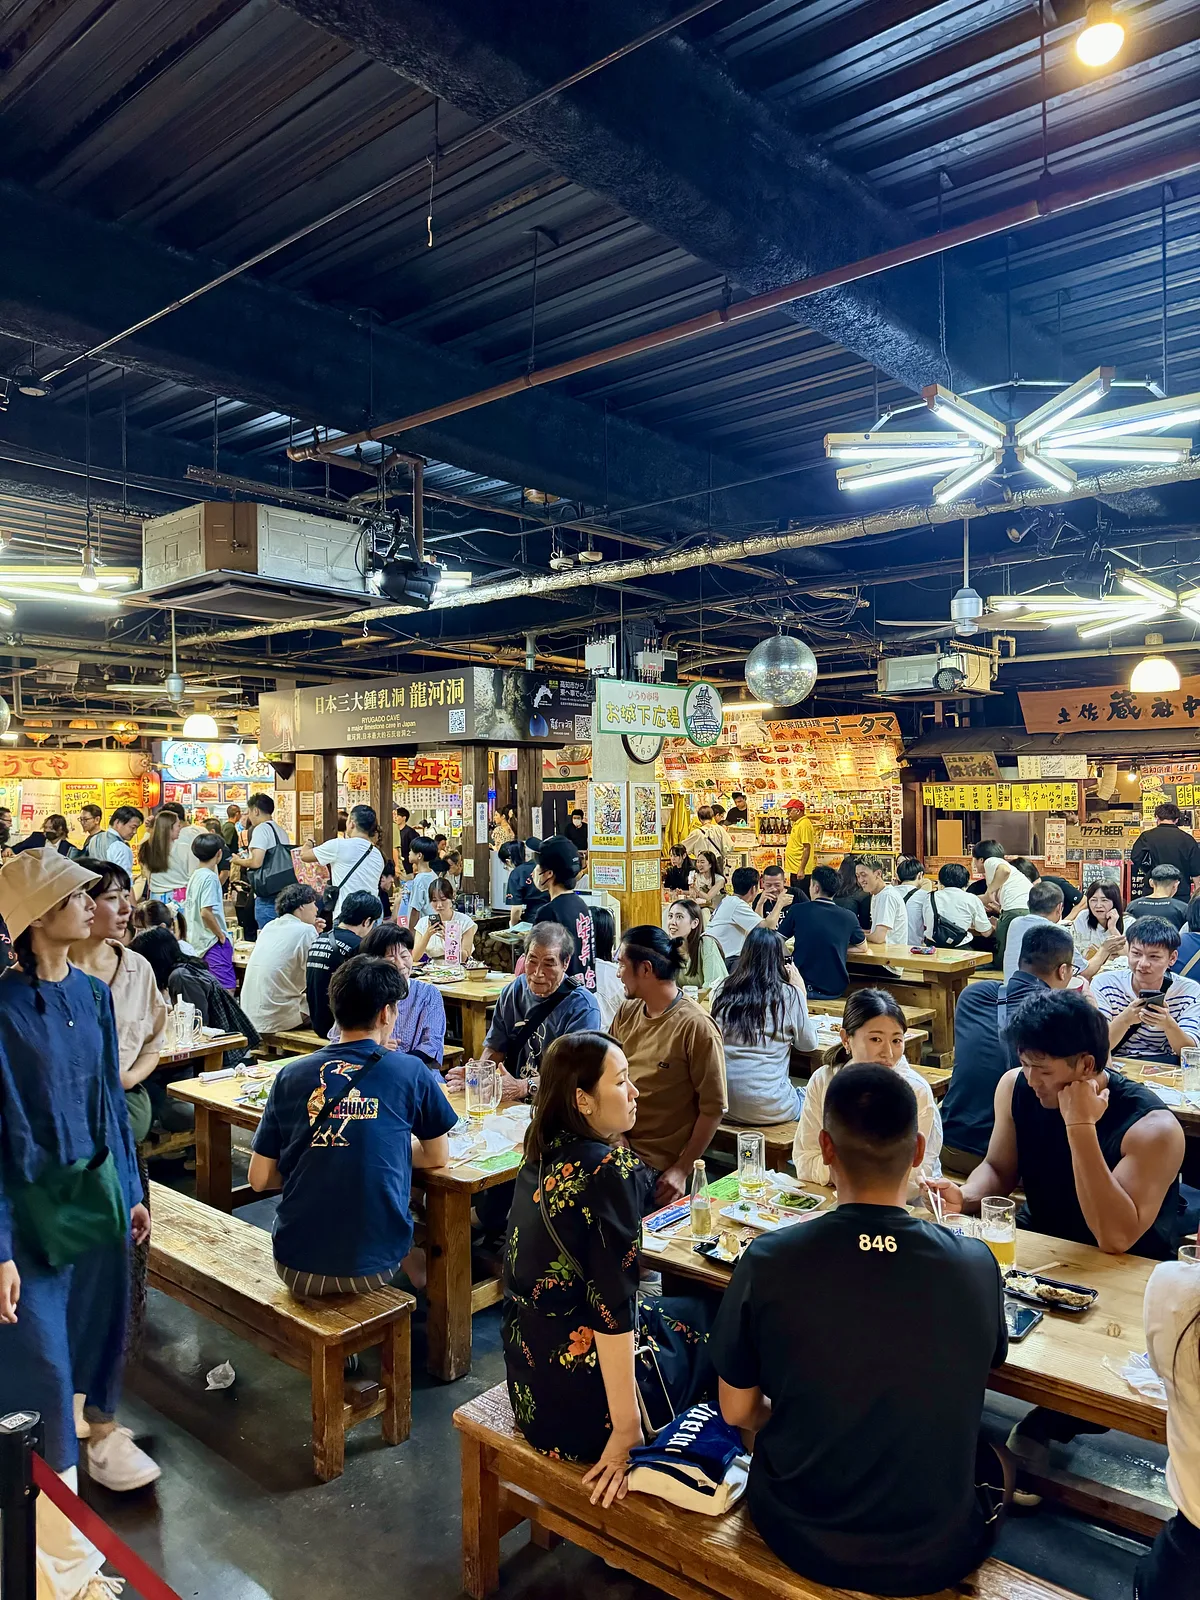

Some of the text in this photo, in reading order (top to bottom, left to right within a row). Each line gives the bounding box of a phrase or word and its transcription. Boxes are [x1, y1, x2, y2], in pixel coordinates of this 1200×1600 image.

[315, 677, 465, 715] 日本三大鍾乳洞 龍河洞
[386, 713, 400, 722] CAVE
[606, 701, 681, 729] お城下広場
[822, 716, 895, 735] ゴータマ
[858, 1233, 898, 1253] 846
